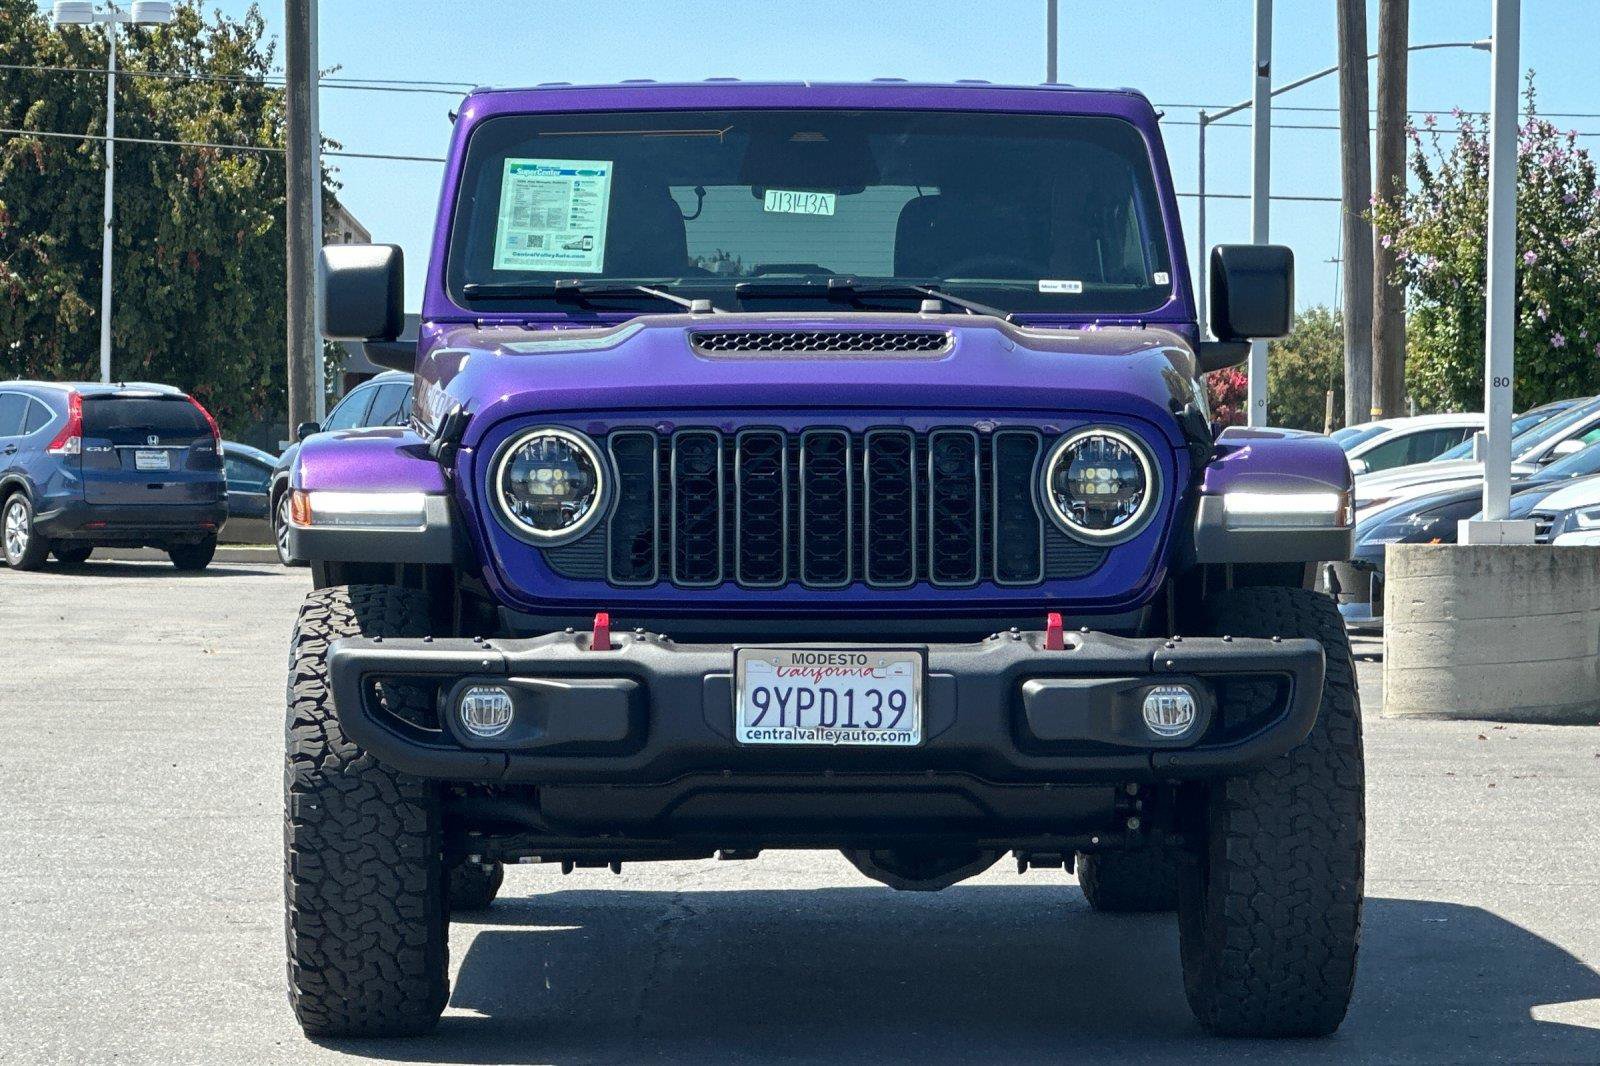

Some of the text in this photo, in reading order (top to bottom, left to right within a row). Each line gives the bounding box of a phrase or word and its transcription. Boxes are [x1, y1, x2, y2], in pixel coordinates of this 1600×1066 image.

[766, 191, 830, 214] J13143A
[1493, 376, 1510, 388] 80
[791, 652, 868, 666] MODESTO
[751, 686, 907, 729] 9YPD139
[746, 727, 911, 745] centralvalleyauto.com
